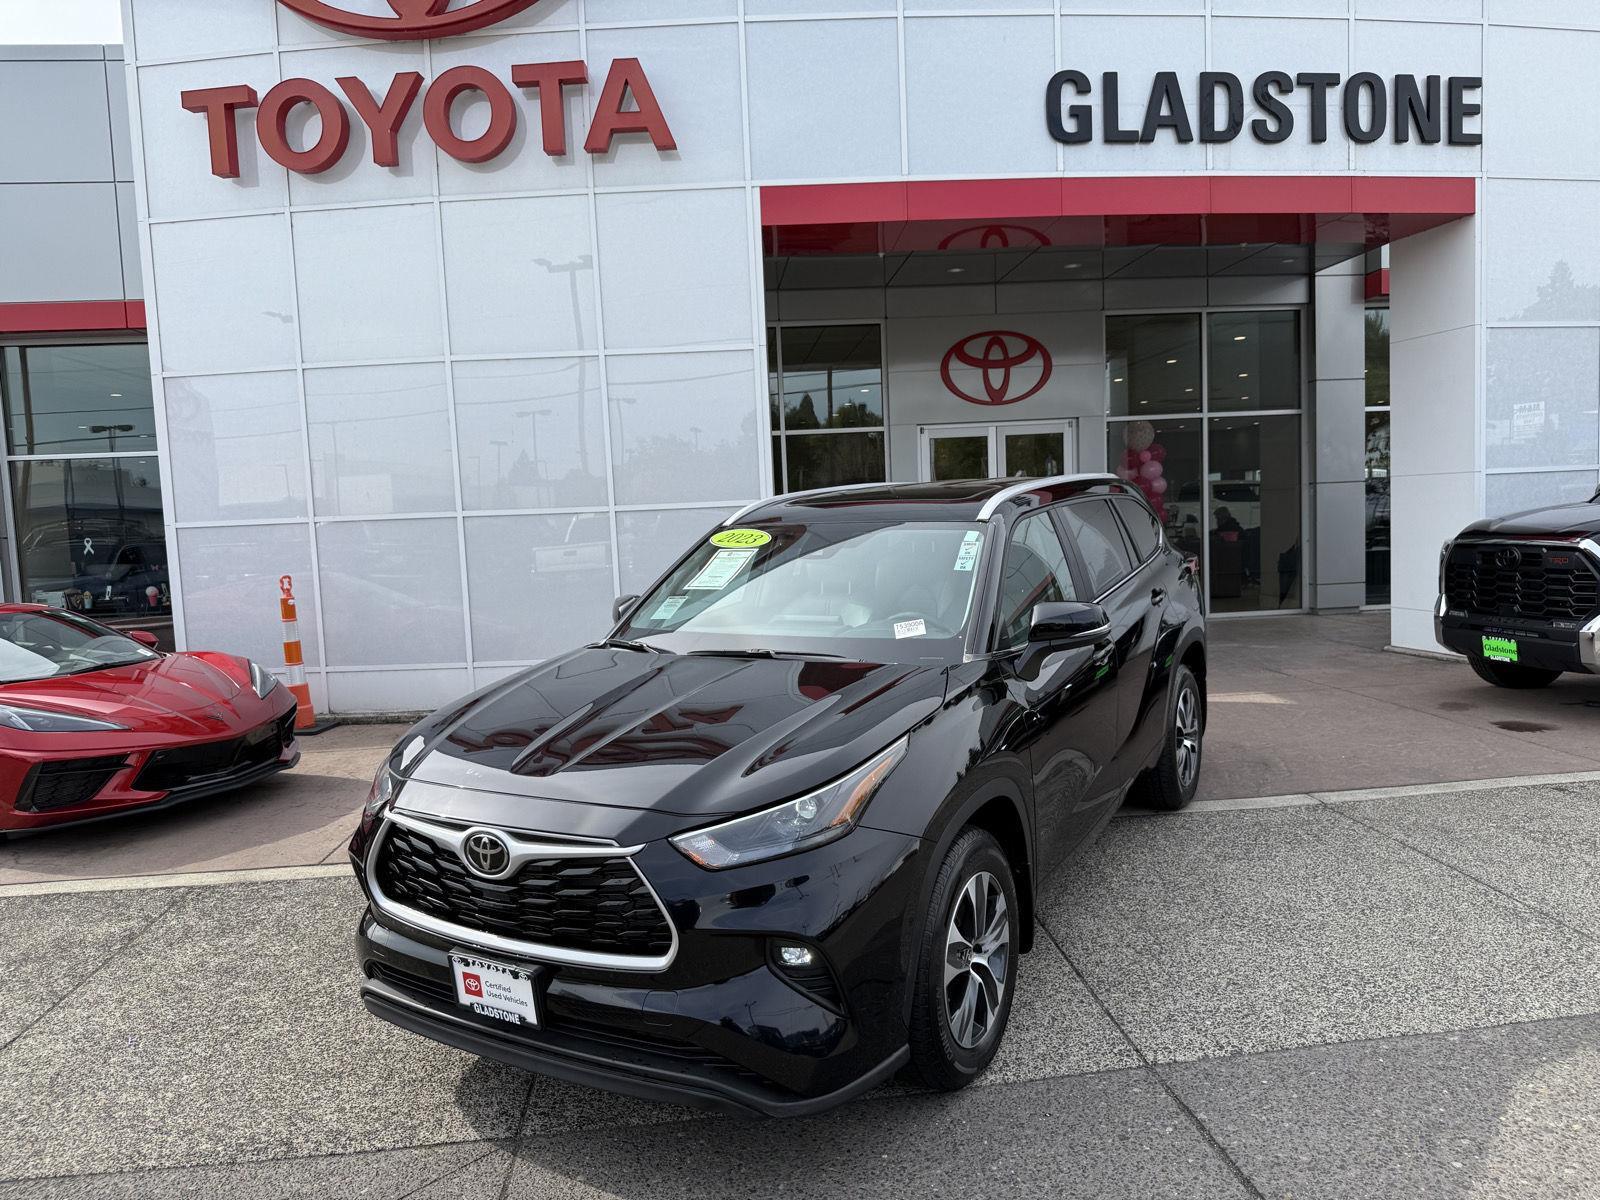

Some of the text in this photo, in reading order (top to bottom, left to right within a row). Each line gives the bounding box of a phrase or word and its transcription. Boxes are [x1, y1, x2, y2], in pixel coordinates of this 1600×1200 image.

[1045, 70, 1482, 146] GLADSTONE
[181, 58, 677, 180] TOYOTA
[716, 532, 765, 545] 2023
[1550, 557, 1569, 565] TRD
[1484, 643, 1517, 655] Gladstone
[468, 959, 511, 975] TOYOTA
[484, 980, 512, 993] Certified
[486, 990, 528, 1007] Used Vehicles
[473, 1003, 521, 1025] GLADSTONE
